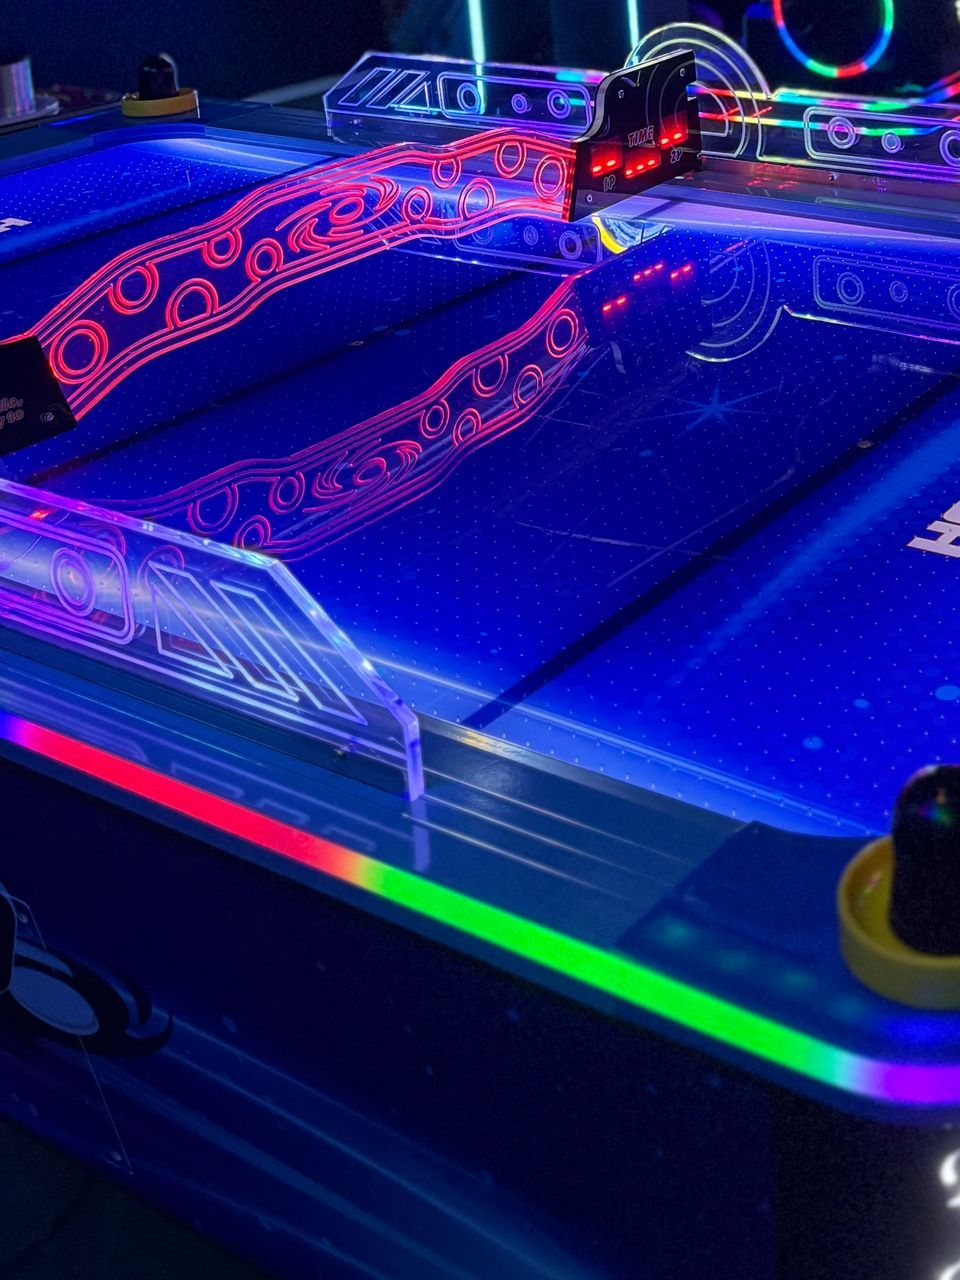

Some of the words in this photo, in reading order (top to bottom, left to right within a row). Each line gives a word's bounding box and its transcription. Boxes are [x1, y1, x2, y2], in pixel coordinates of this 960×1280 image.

[628, 125, 654, 148] TIME
[670, 147, 684, 165] 2P
[602, 174, 617, 193] 1P
